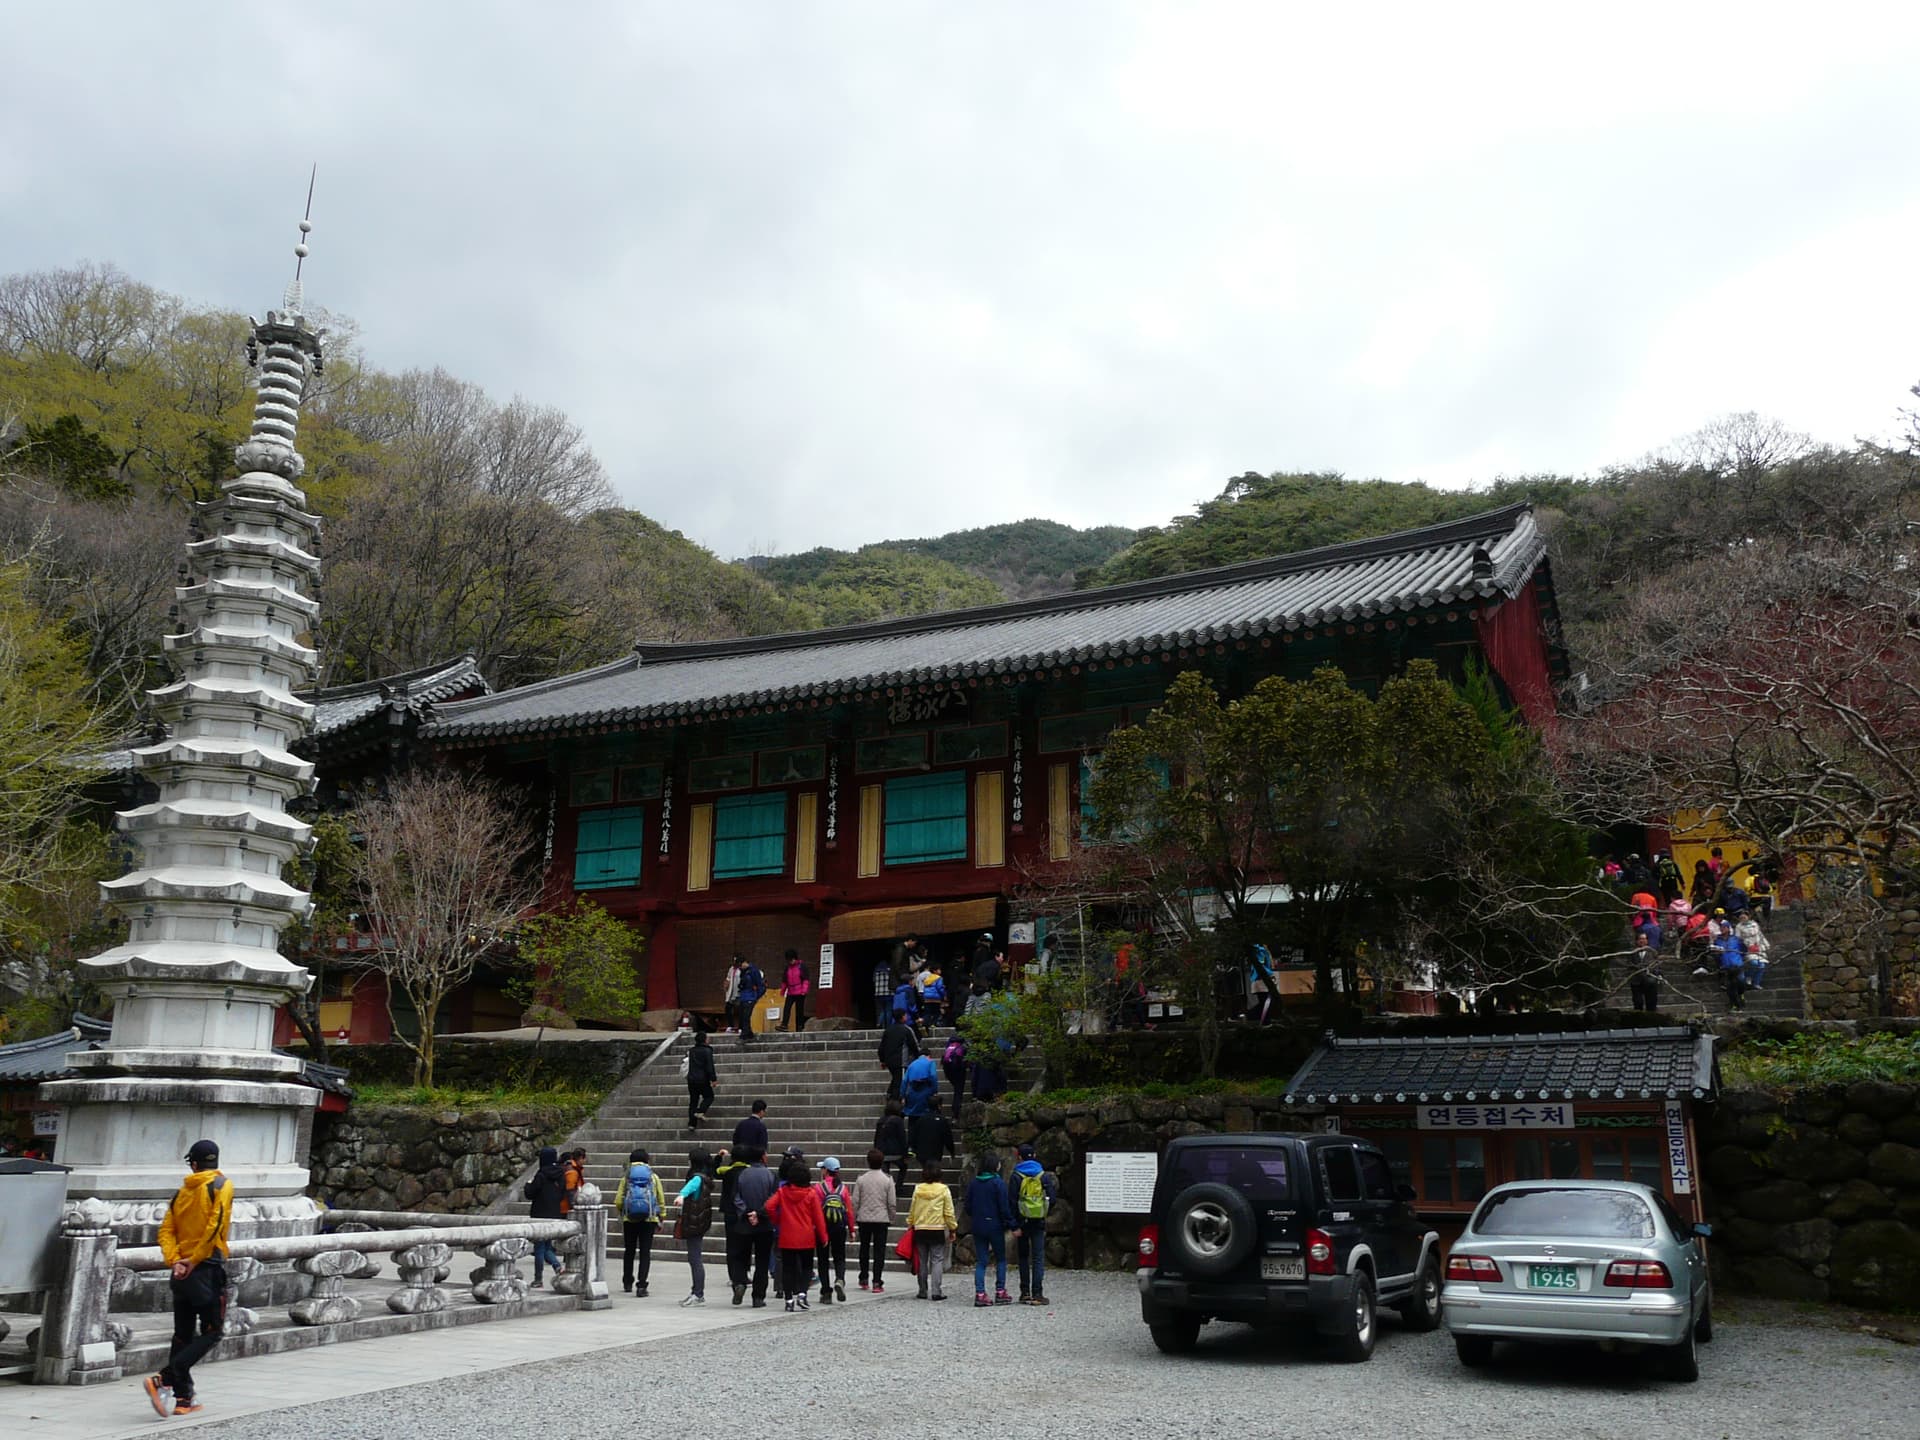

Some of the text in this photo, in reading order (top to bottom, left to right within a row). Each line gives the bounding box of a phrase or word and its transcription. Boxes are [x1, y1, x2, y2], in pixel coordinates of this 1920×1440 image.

[1427, 1106, 1565, 1127] 연등접수처
[1667, 1108, 1689, 1186] 연등접수
[1533, 1271, 1576, 1288] 1945
